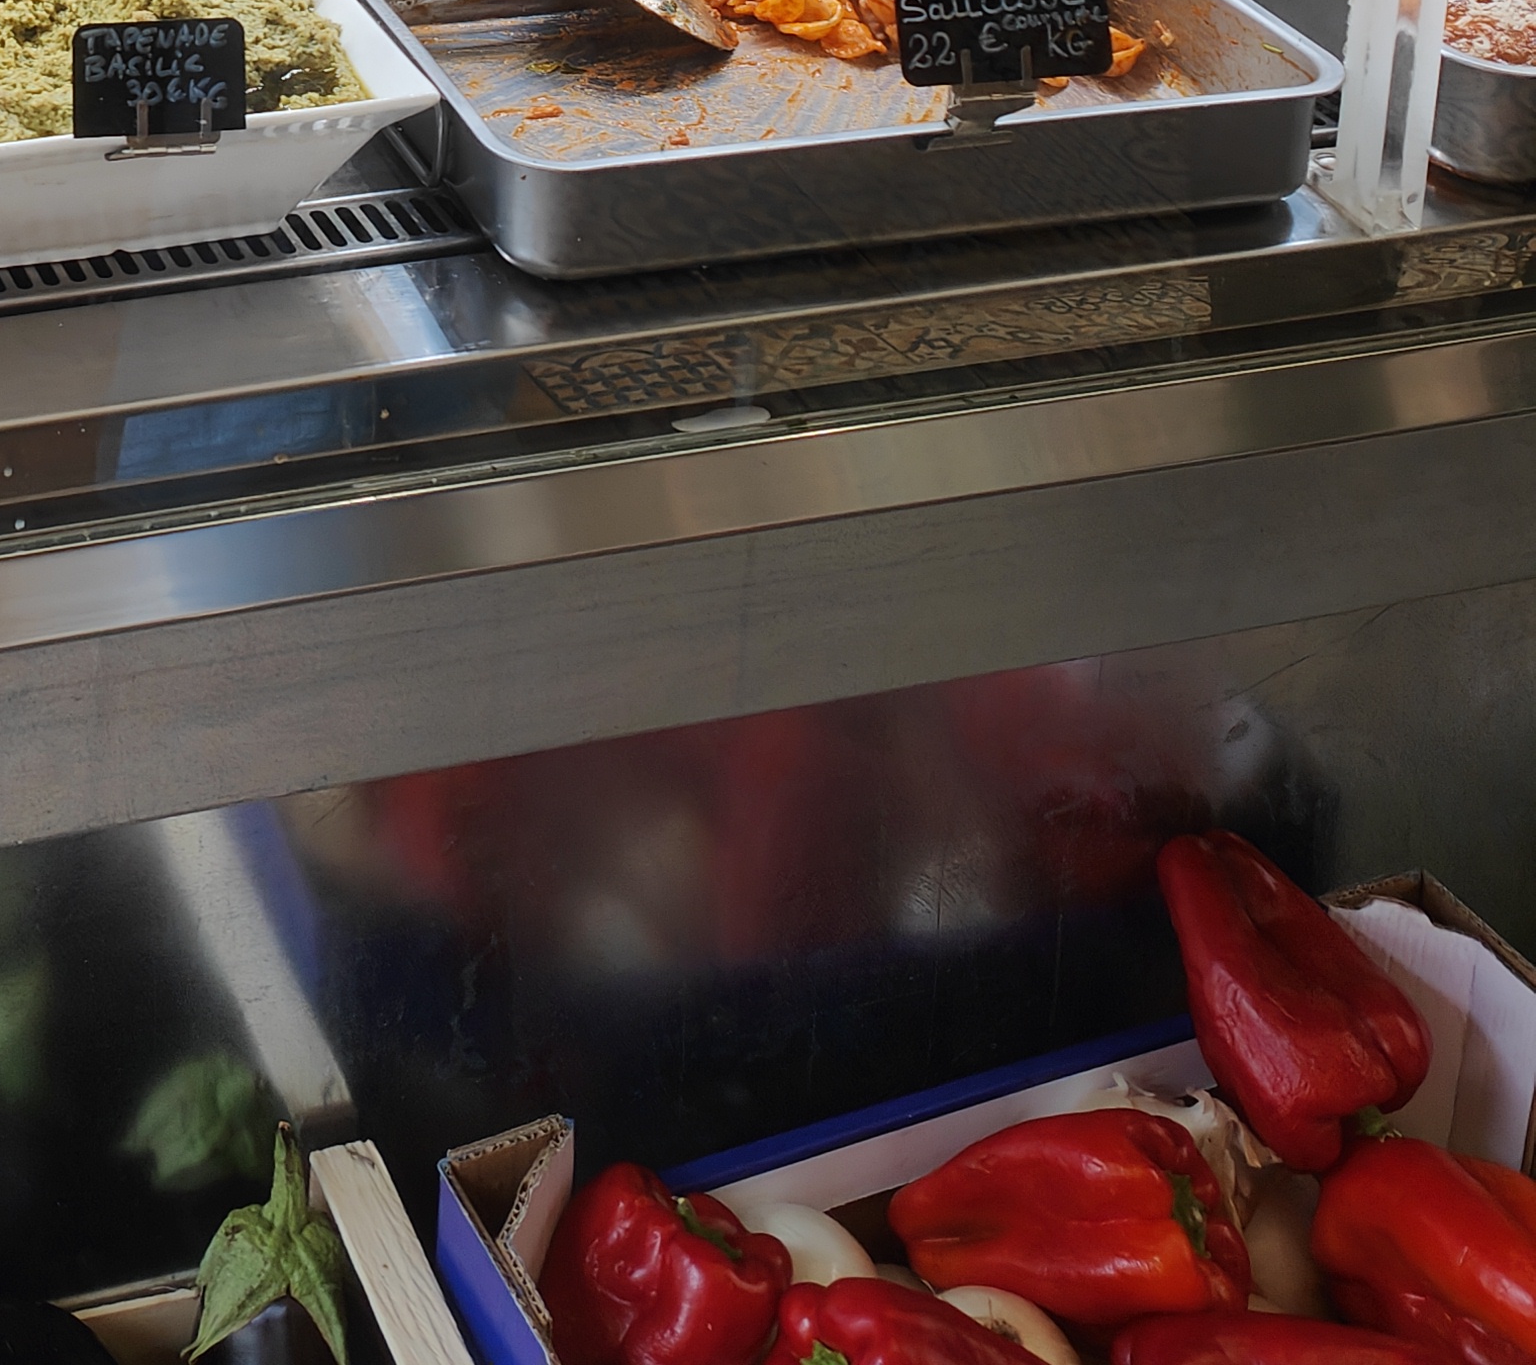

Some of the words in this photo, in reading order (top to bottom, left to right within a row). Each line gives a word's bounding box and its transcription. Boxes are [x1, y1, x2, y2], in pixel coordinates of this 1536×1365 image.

[75, 23, 229, 54] TAPENADE
[909, 32, 955, 69] 22
[978, 22, 1008, 52] €
[1047, 24, 1093, 58] KG
